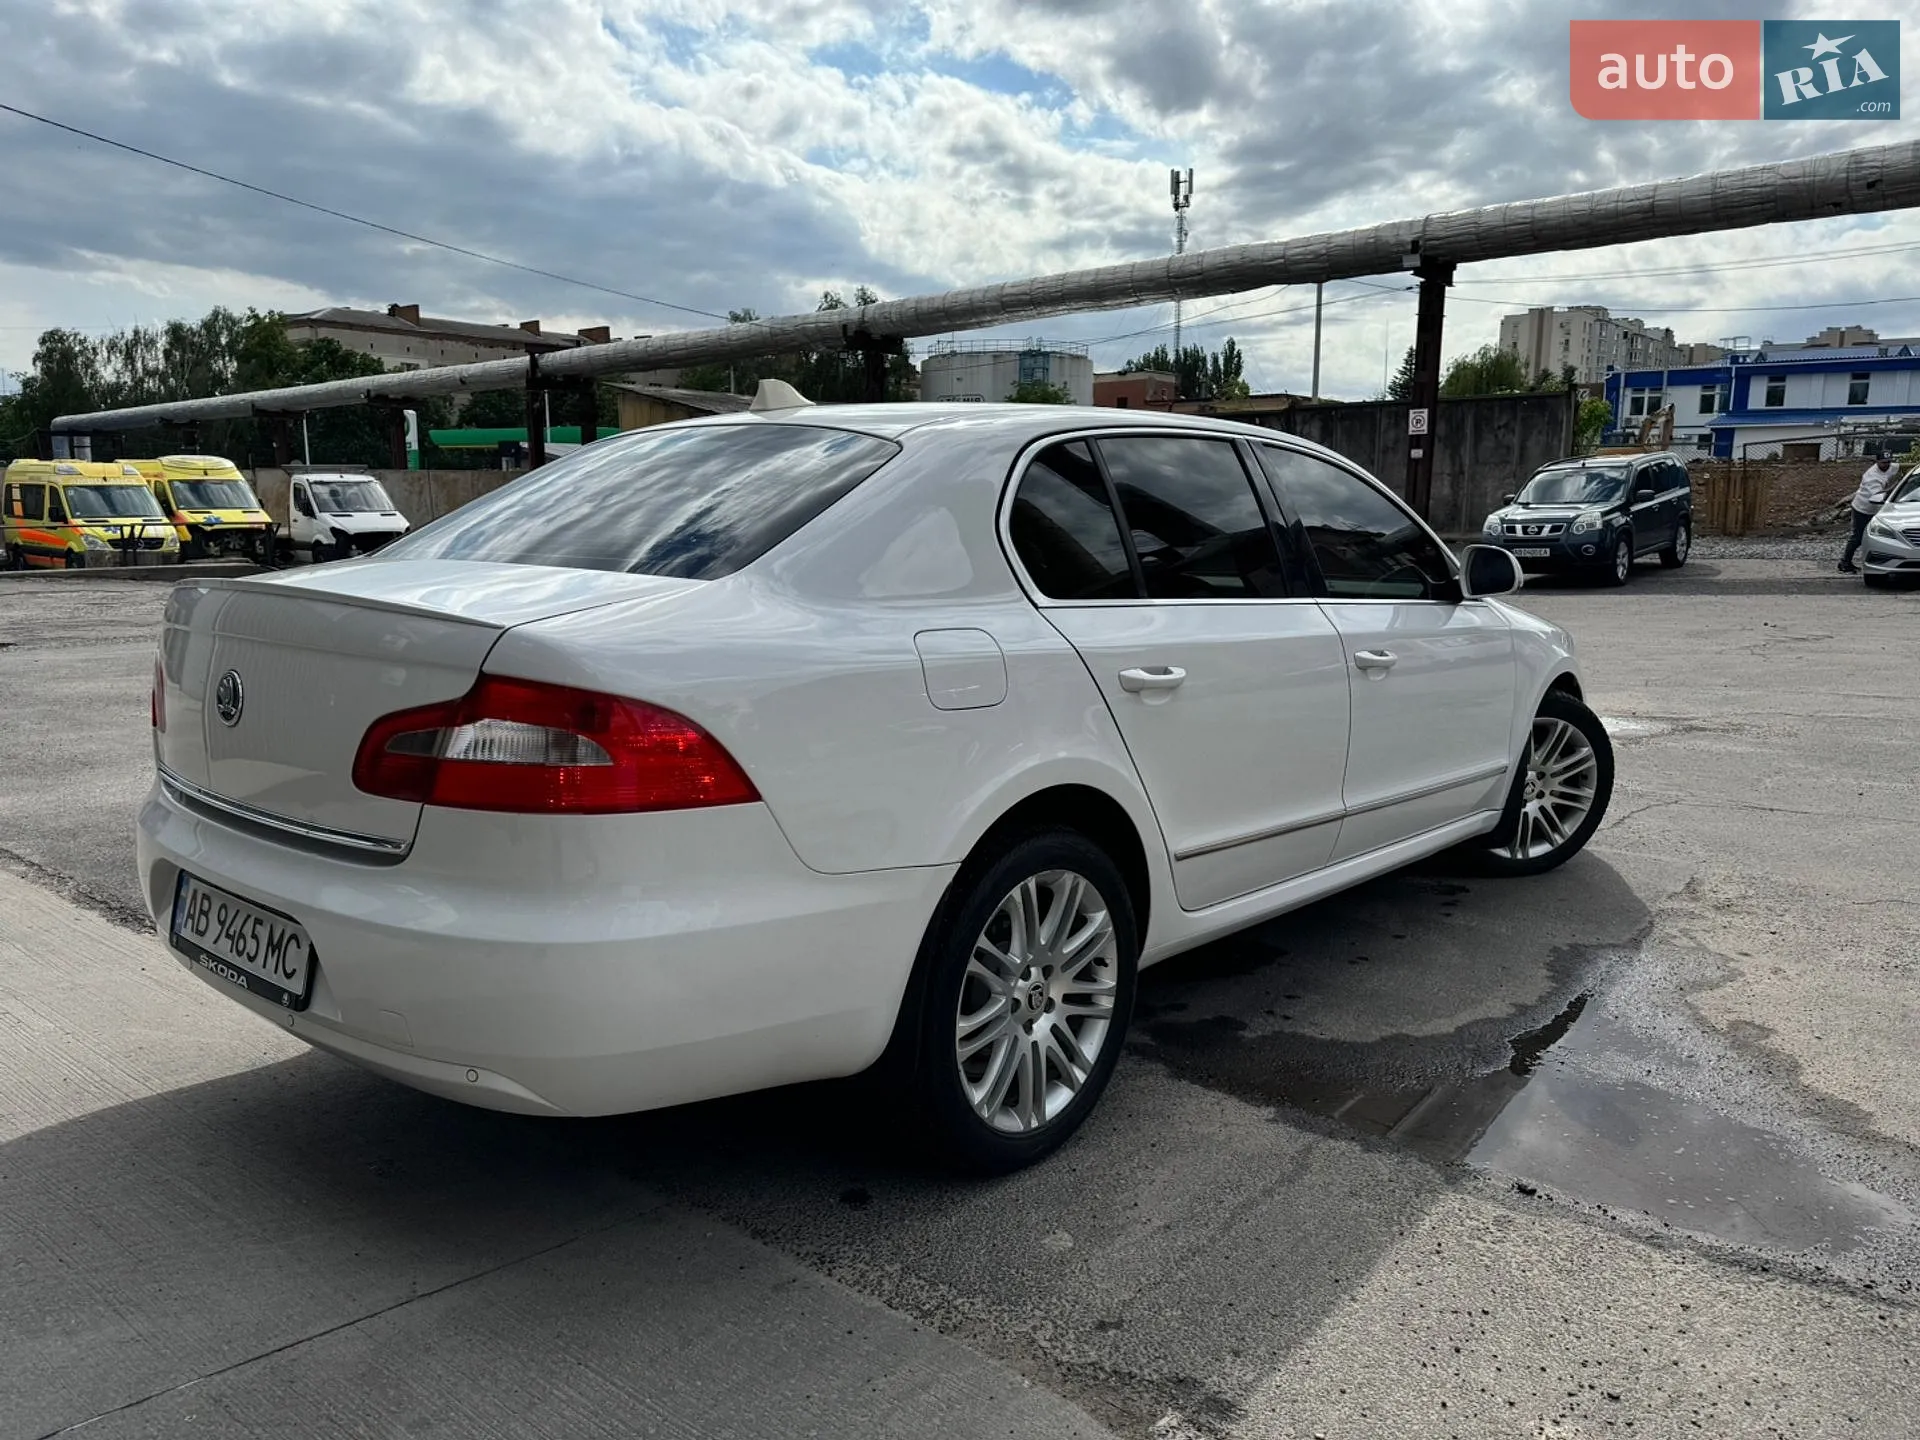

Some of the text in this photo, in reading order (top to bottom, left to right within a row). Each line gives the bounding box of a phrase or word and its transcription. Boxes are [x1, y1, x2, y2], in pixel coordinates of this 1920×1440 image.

[184, 888, 302, 980] AB 9465 MC
